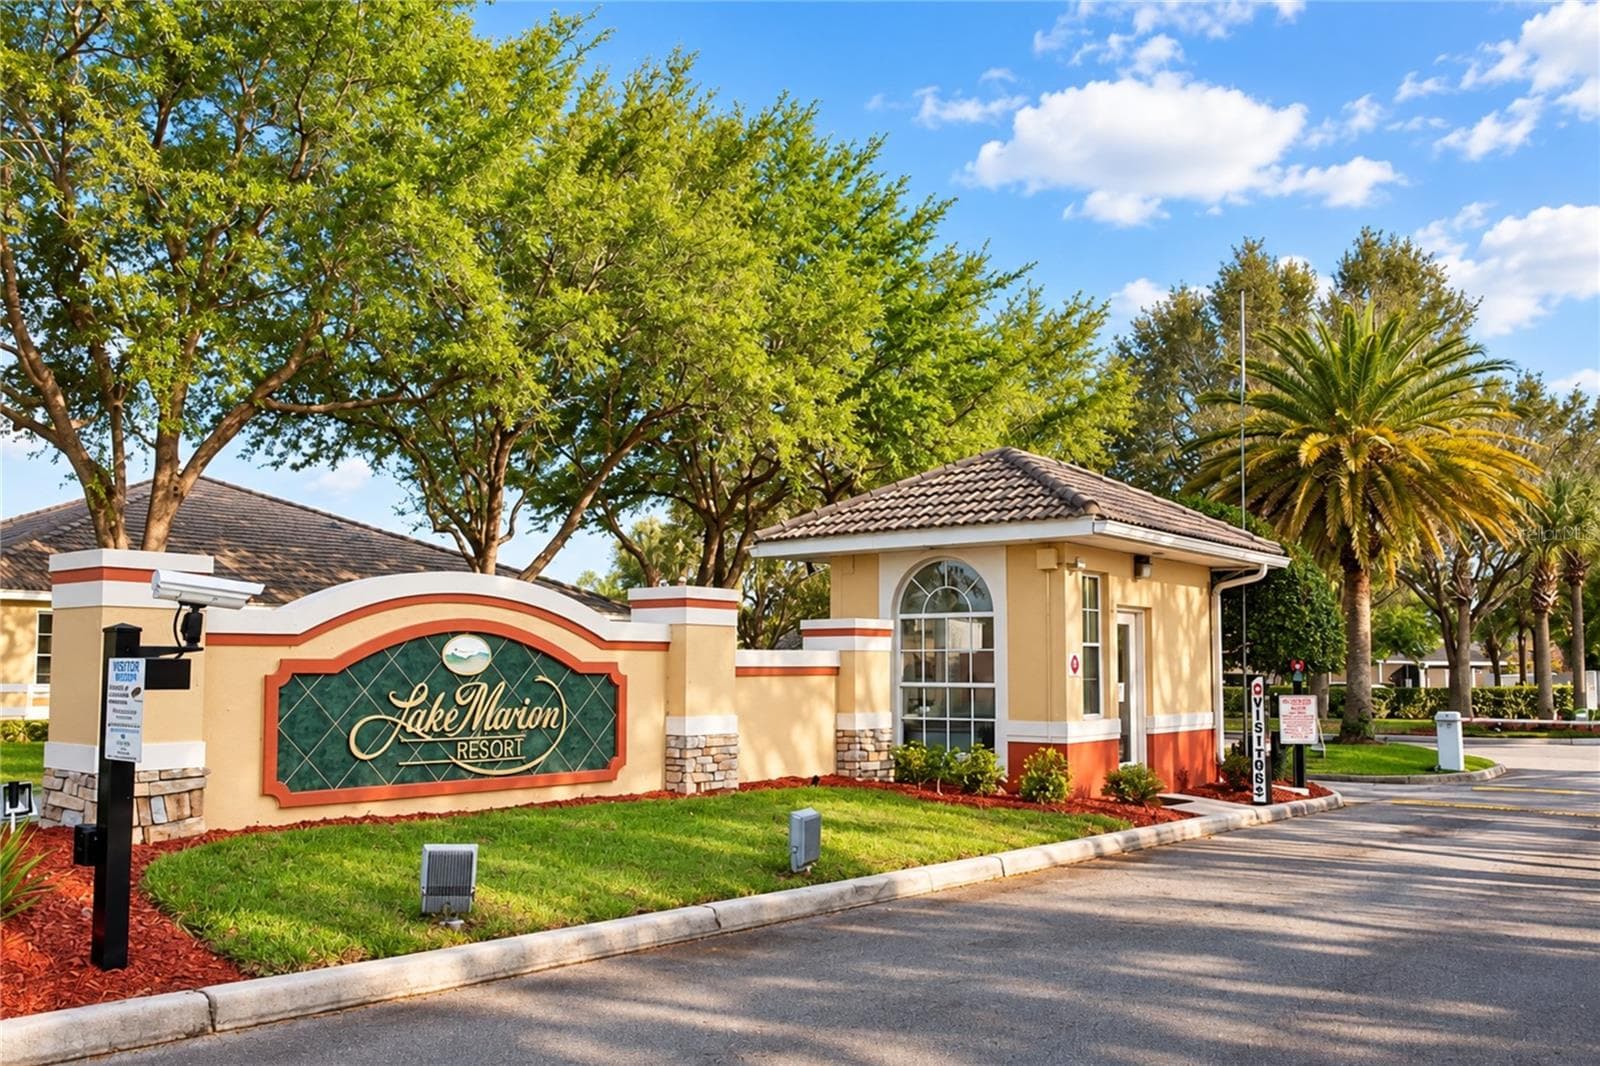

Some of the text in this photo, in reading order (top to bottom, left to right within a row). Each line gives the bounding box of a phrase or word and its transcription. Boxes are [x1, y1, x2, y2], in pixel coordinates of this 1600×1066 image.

[349, 681, 560, 761] Lake Marion
[457, 738, 525, 760] RESORT
